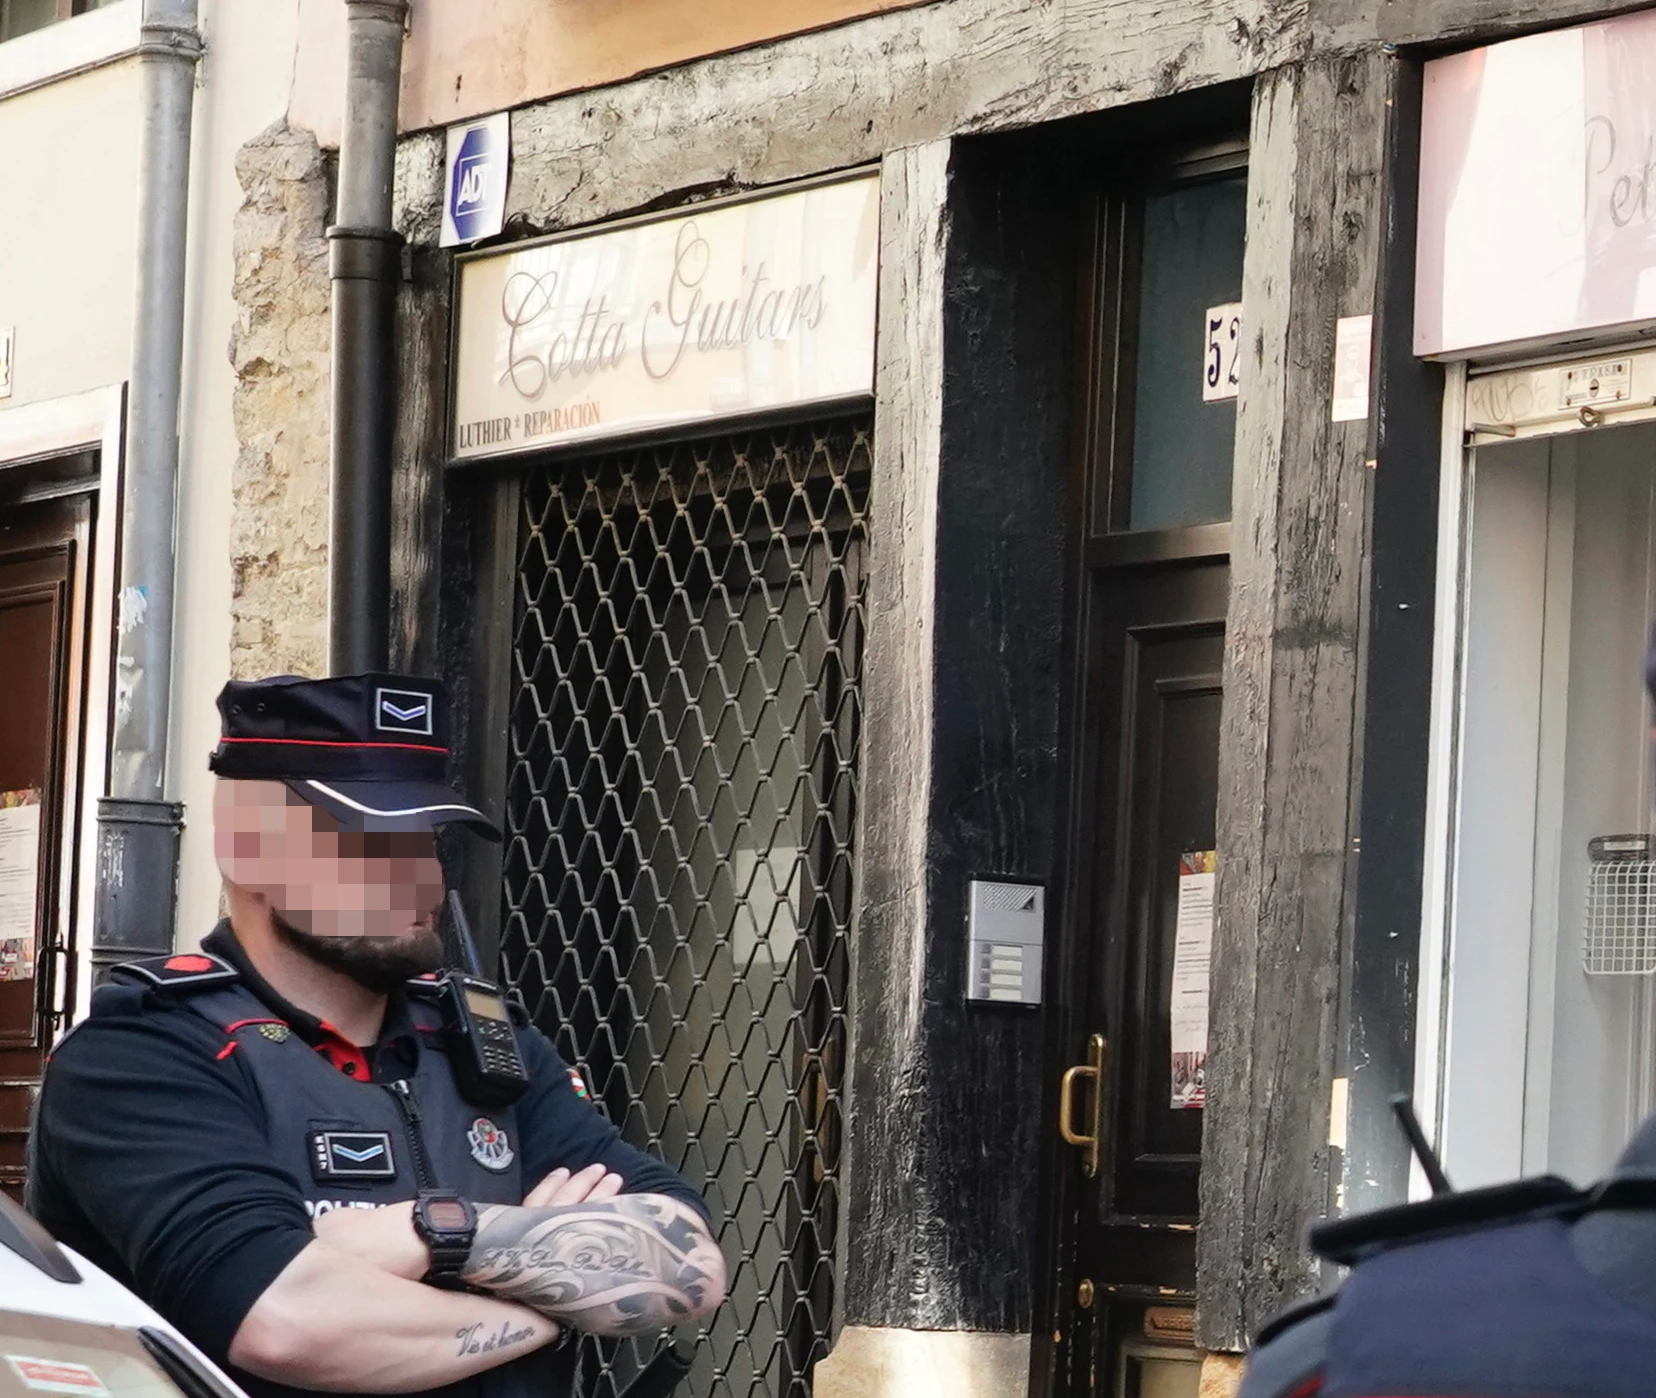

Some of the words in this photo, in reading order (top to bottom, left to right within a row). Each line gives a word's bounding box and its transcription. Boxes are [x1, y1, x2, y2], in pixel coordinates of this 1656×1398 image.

[498, 270, 627, 400] Cotta
[641, 220, 829, 381] Guitars
[459, 417, 512, 448] LUTHIER
[524, 395, 600, 438] REPARACIÓN
